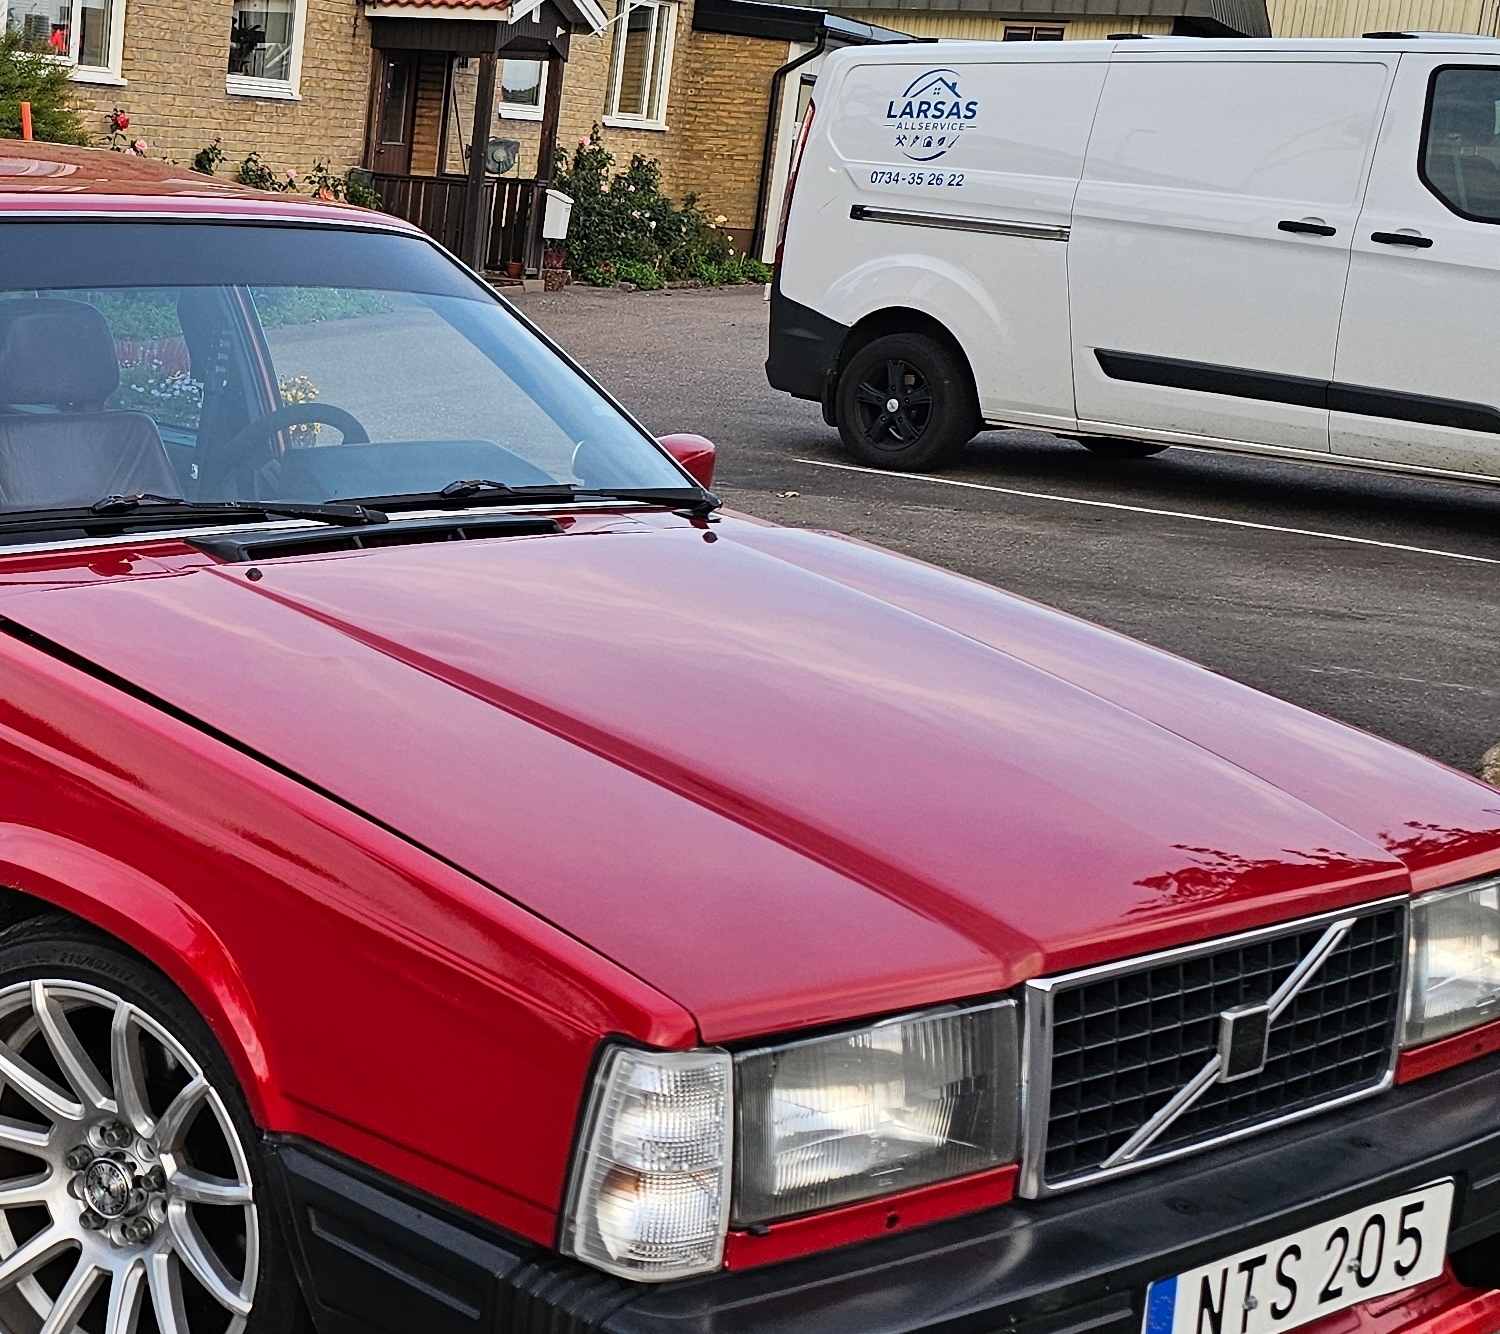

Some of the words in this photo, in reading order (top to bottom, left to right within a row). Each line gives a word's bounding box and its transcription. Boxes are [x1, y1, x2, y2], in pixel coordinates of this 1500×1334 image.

[886, 100, 979, 120] LARSAS
[896, 121, 966, 131] ALLSERVICE
[927, 172, 945, 186] 26
[947, 173, 965, 187] 22
[1317, 1200, 1425, 1305] 205
